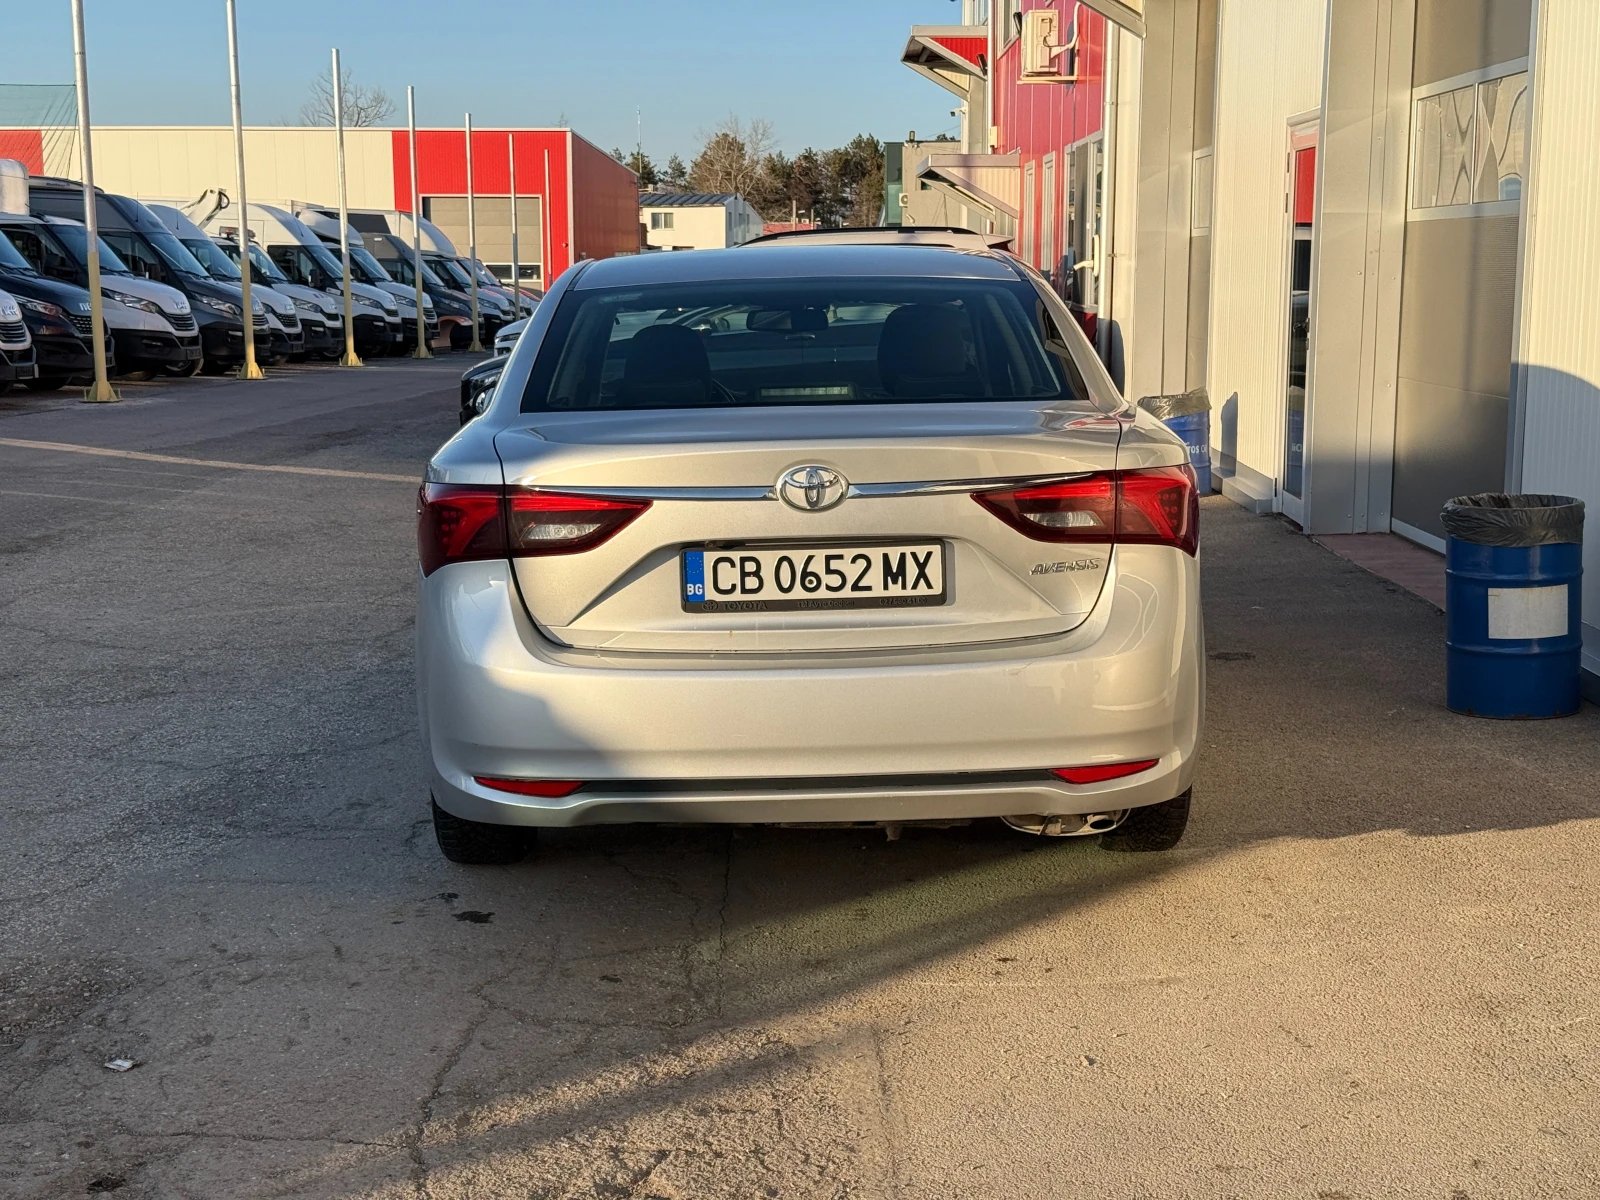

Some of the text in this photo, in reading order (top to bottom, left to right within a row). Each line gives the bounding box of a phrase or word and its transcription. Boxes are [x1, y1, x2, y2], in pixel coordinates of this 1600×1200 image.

[712, 551, 934, 595] CB 0652 MX
[1029, 558, 1100, 575] AVENSIS
[687, 583, 703, 595] BG
[723, 601, 768, 611] TOYOTA
